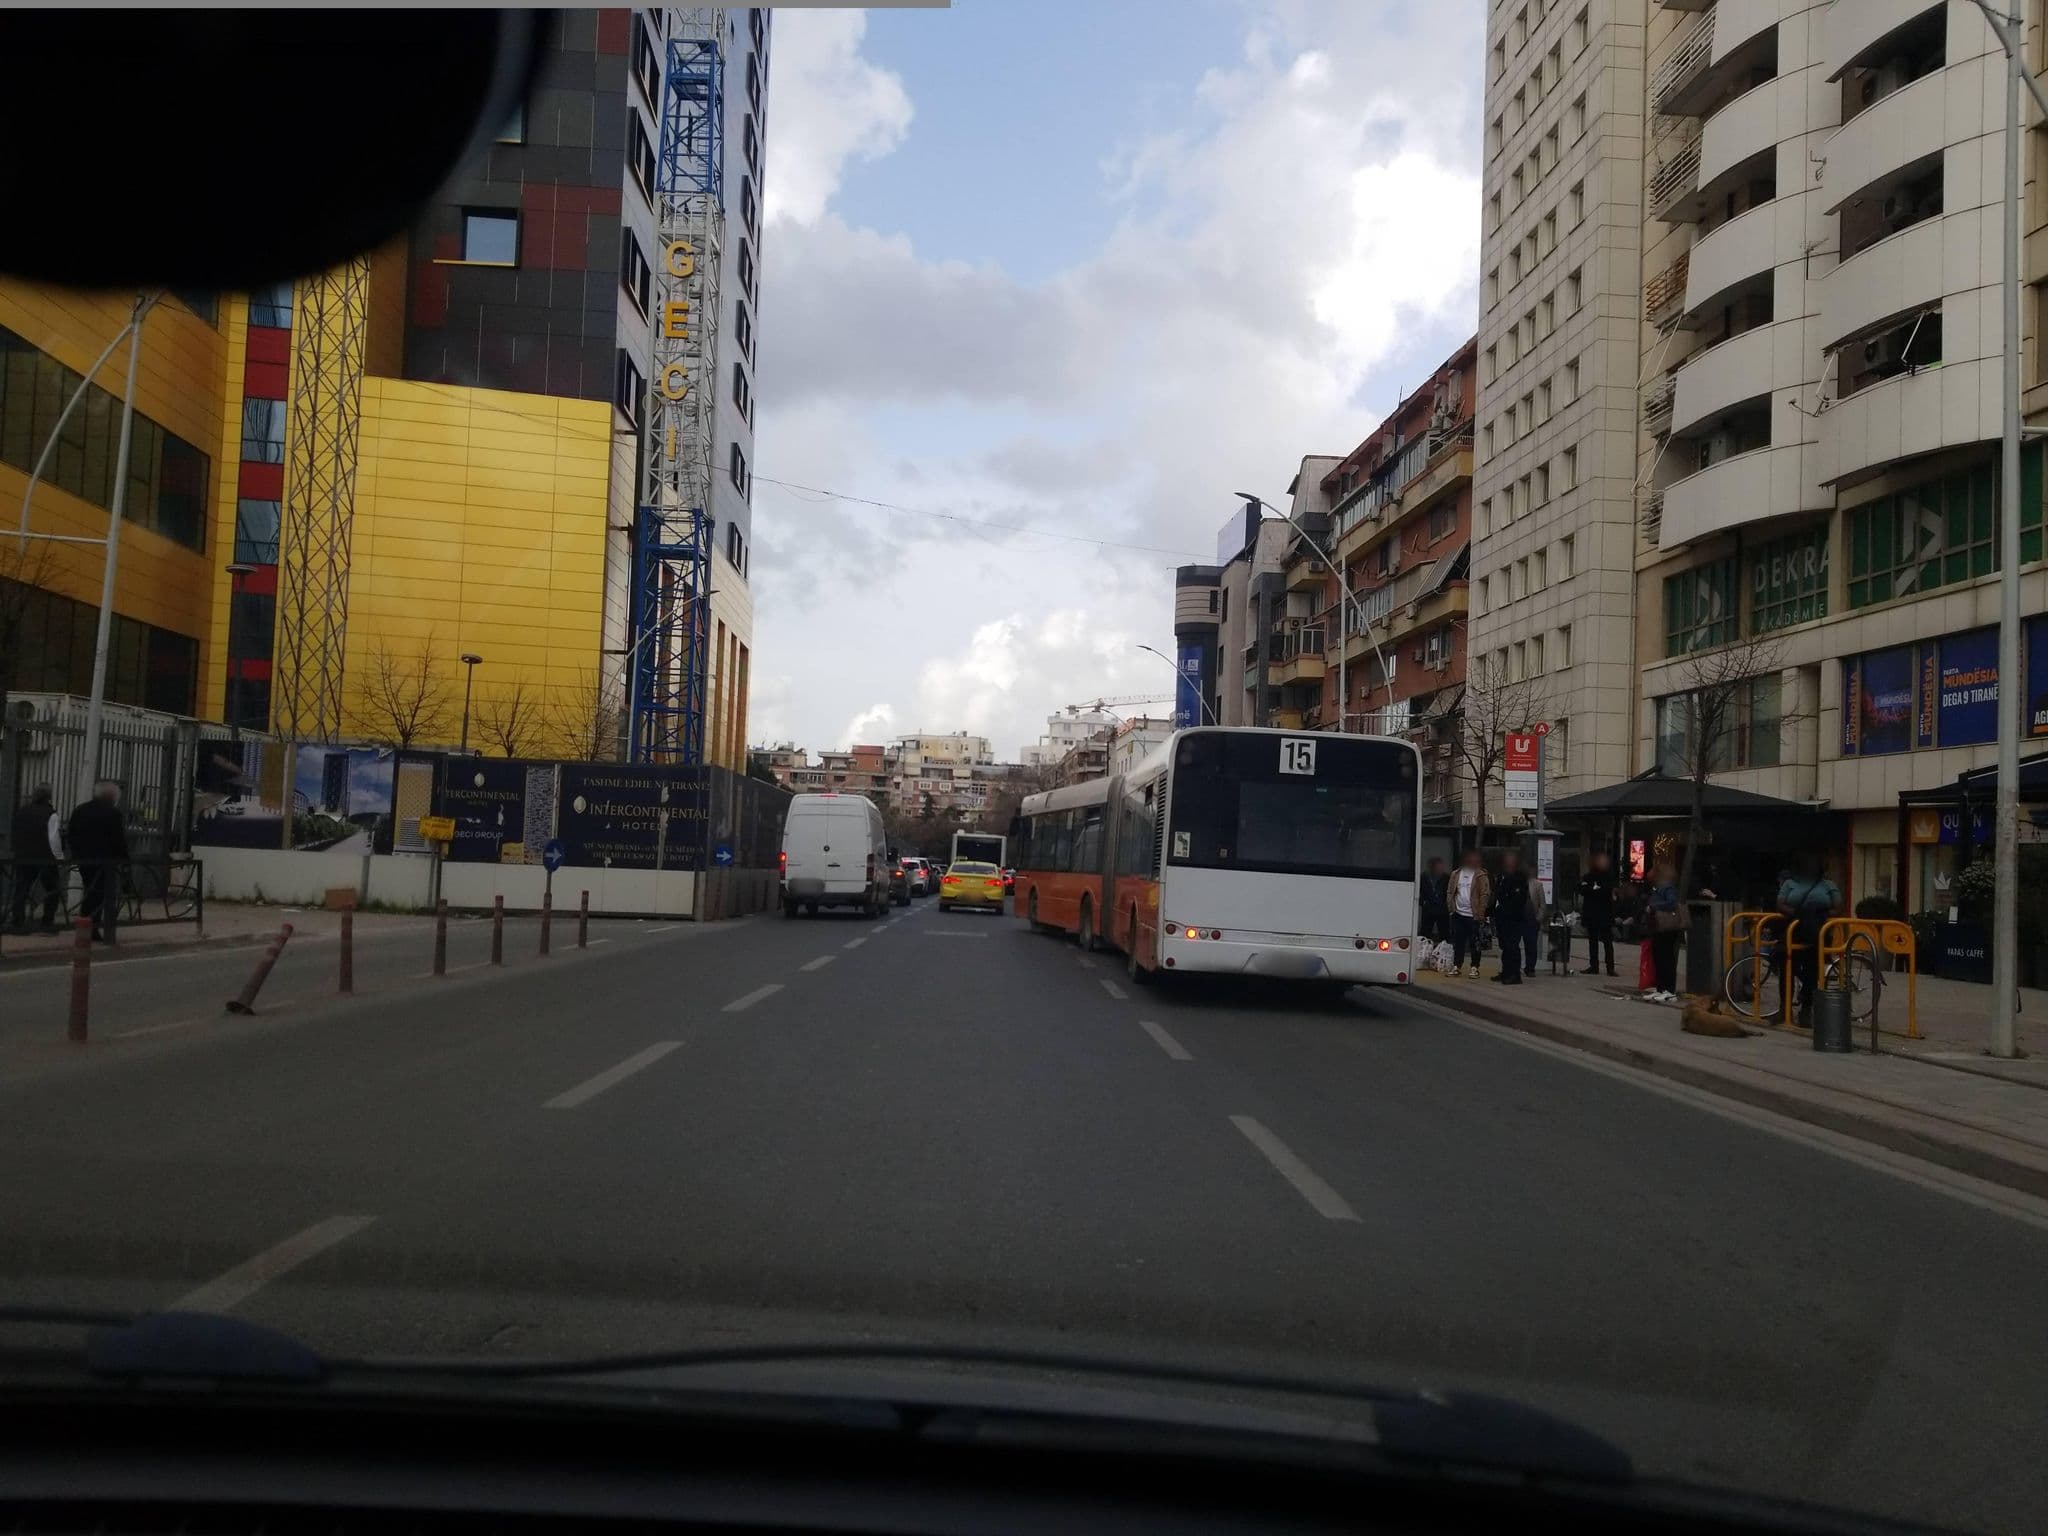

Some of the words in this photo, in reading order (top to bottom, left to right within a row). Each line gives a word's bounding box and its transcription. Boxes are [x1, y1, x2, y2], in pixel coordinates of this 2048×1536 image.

[1754, 538, 1831, 593] DEKRA
[1943, 667, 1999, 689] MUNDËSIA
[1942, 692, 1962, 708] DEGA
[1963, 691, 1970, 704] 9
[1284, 741, 1311, 770] 15
[622, 821, 662, 832] HOTEL
[1943, 813, 1982, 830] QUN
